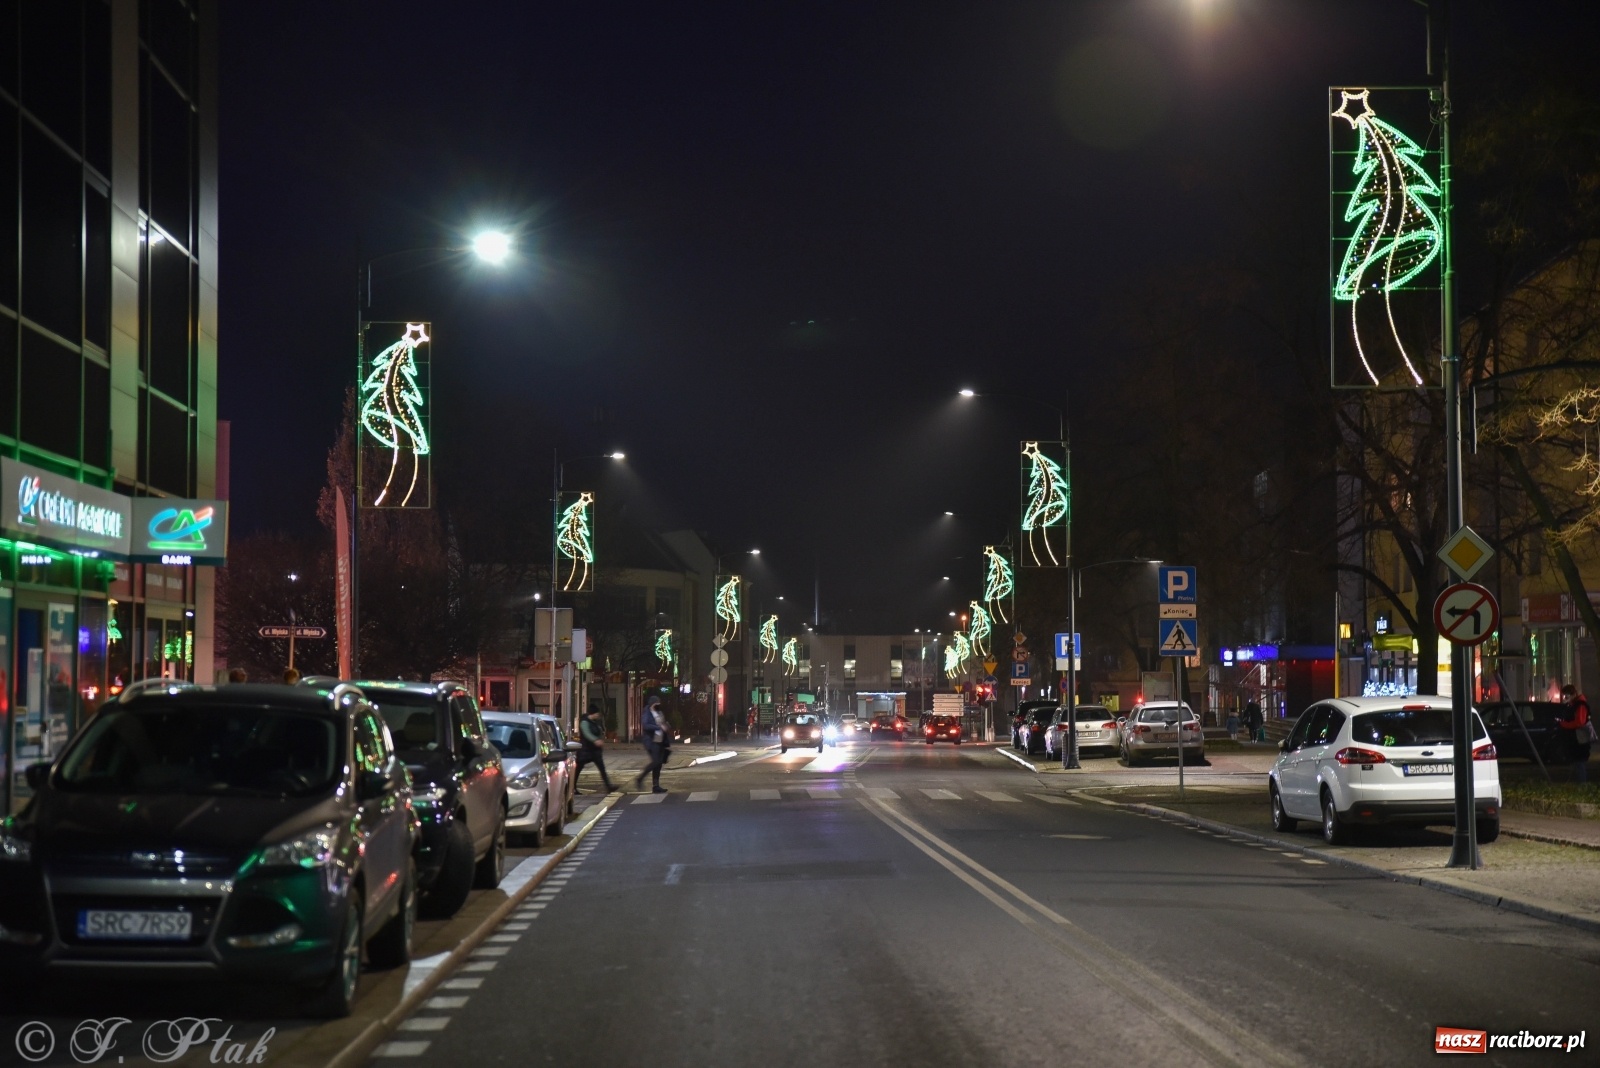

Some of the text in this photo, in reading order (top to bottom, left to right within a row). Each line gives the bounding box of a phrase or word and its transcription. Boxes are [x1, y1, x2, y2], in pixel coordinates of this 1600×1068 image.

[1167, 571, 1189, 599] P
[1016, 663, 1026, 677] P
[90, 913, 189, 934] SRC 7RS9
